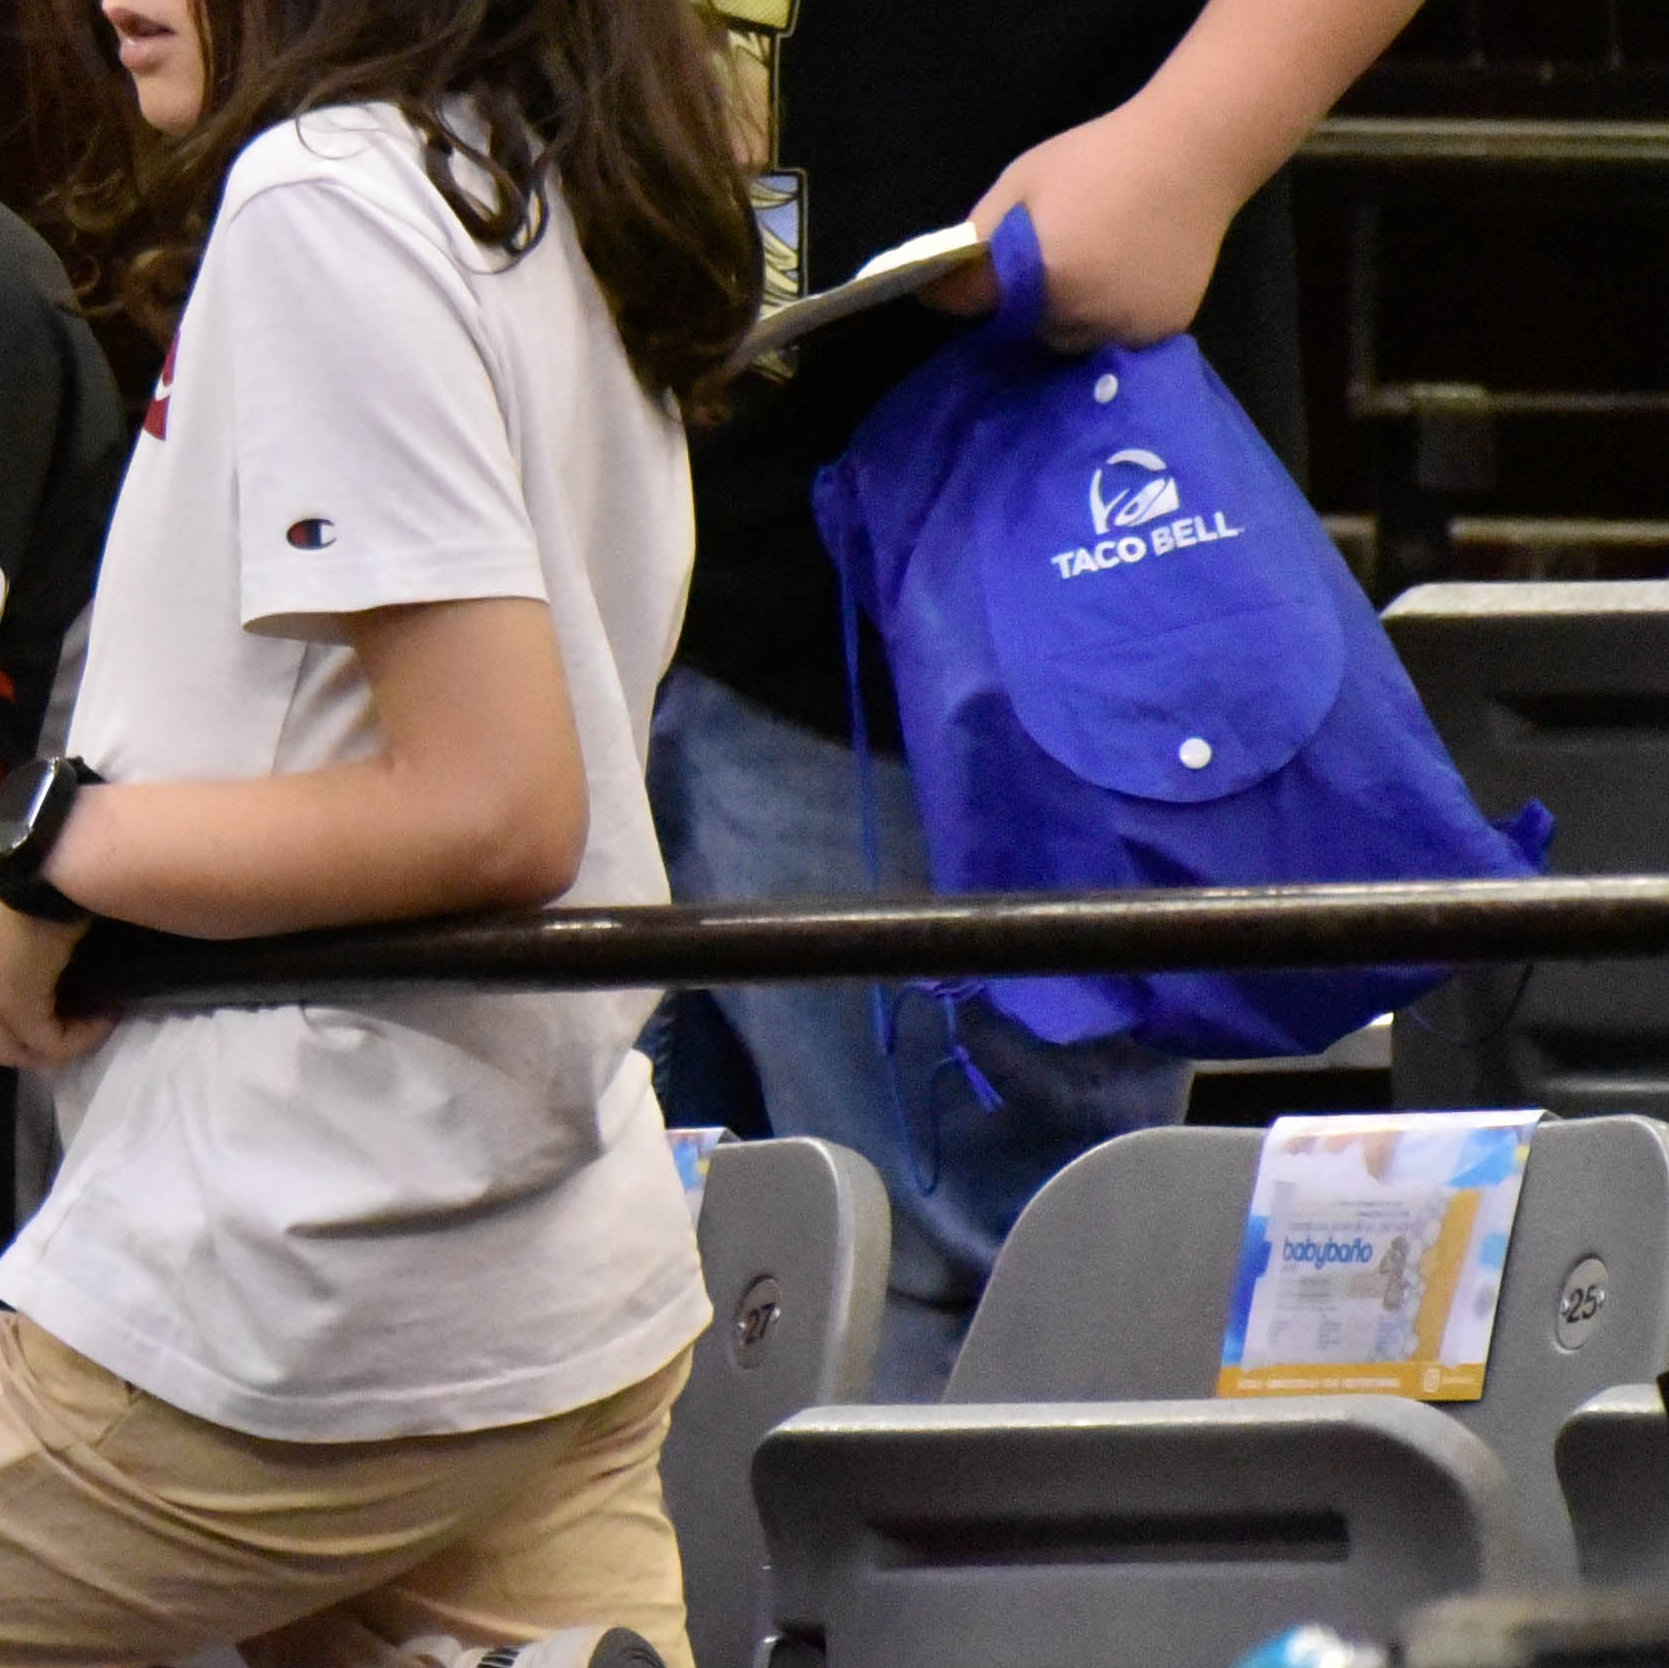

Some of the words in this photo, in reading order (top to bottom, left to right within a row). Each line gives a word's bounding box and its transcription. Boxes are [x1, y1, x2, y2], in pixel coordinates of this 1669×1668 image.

[1050, 535, 1147, 579] TACO
[1150, 511, 1245, 556] BELL
[1566, 1284, 1598, 1323] 25
